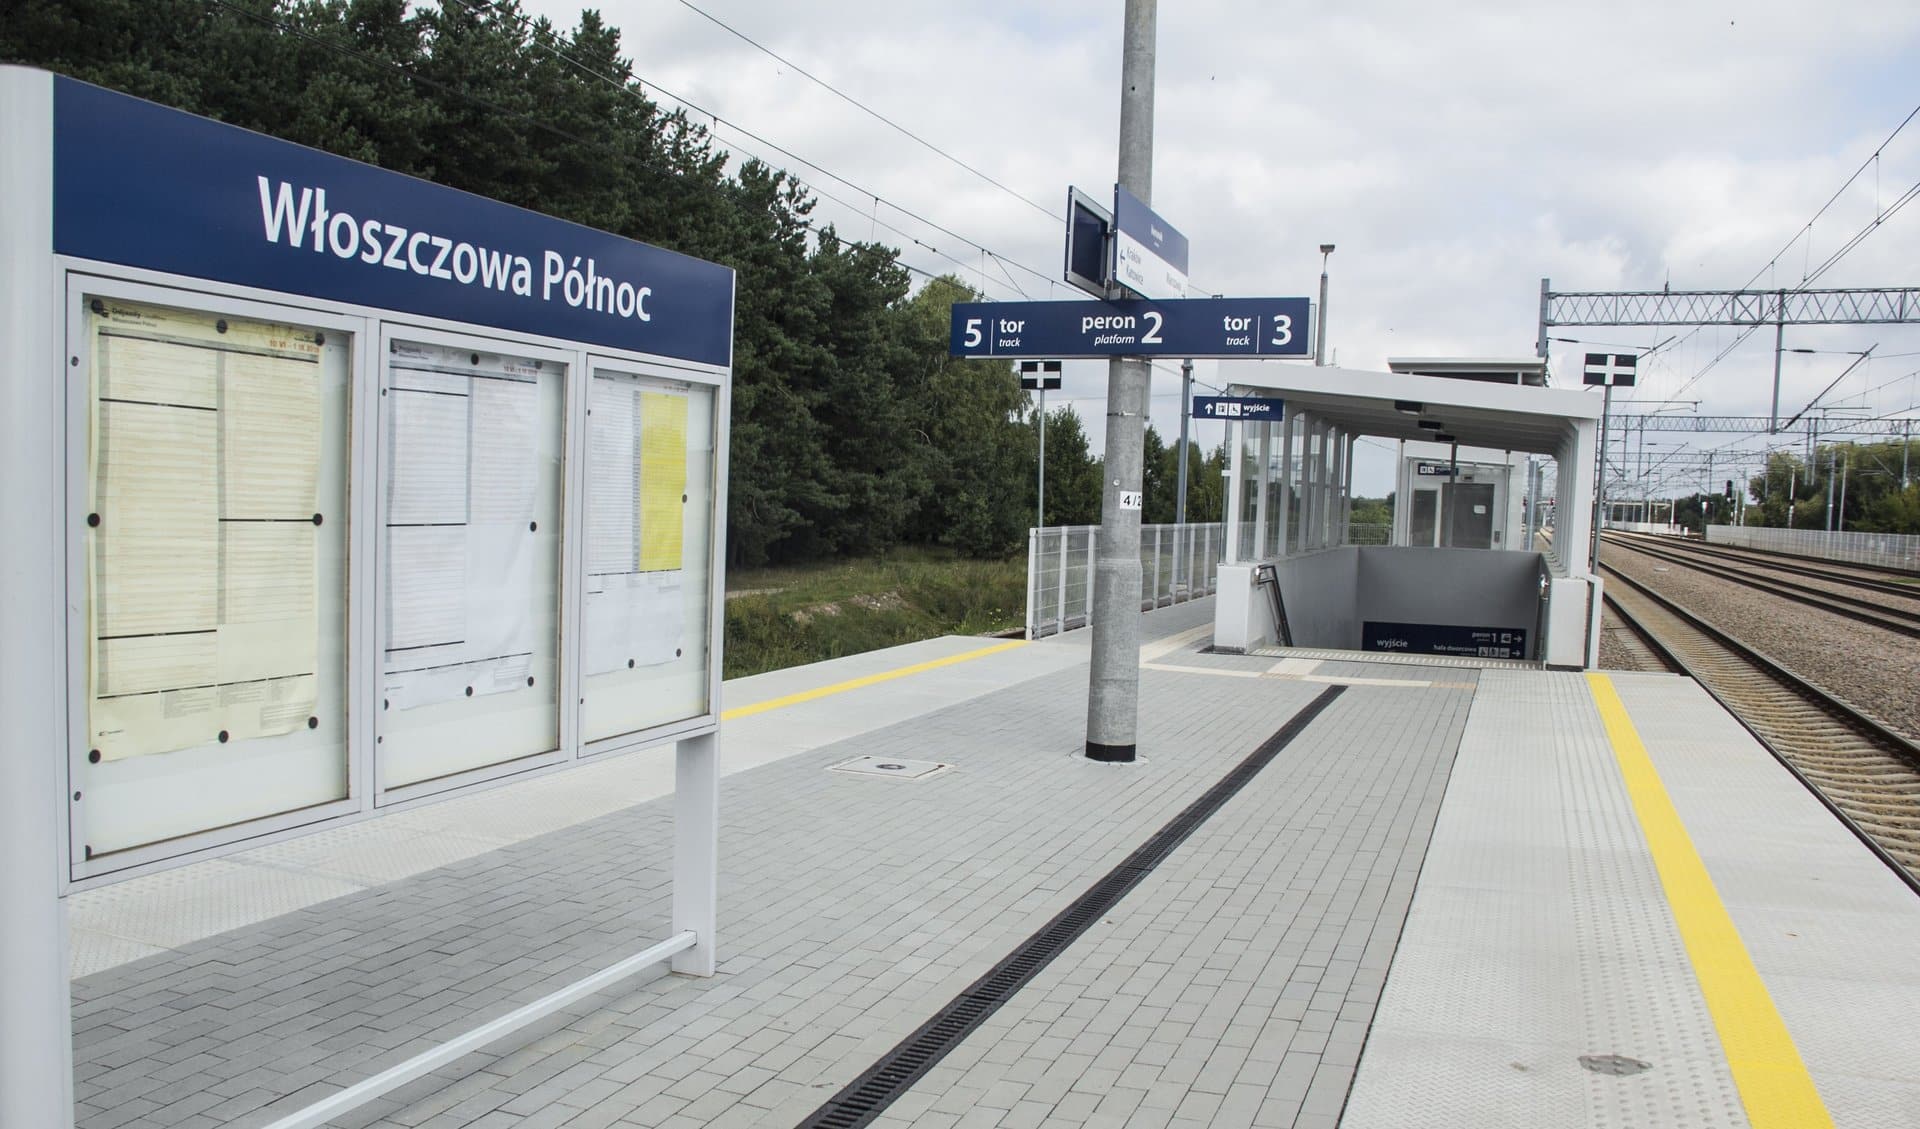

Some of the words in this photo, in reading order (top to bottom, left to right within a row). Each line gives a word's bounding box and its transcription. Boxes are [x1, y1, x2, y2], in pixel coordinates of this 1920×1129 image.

[257, 175, 532, 297] Włoszczowa
[543, 250, 652, 322] Północ
[964, 318, 982, 348] 5
[1000, 318, 1025, 333] tor
[1082, 315, 1136, 334] peron
[1141, 311, 1163, 344] 2
[1223, 315, 1252, 331] tor
[1271, 314, 1292, 346] 3
[999, 338, 1021, 348] track
[1094, 333, 1135, 347] platform
[1226, 336, 1250, 346] track
[1243, 403, 1270, 412] wyjście
[1376, 638, 1408, 648] wyjście
